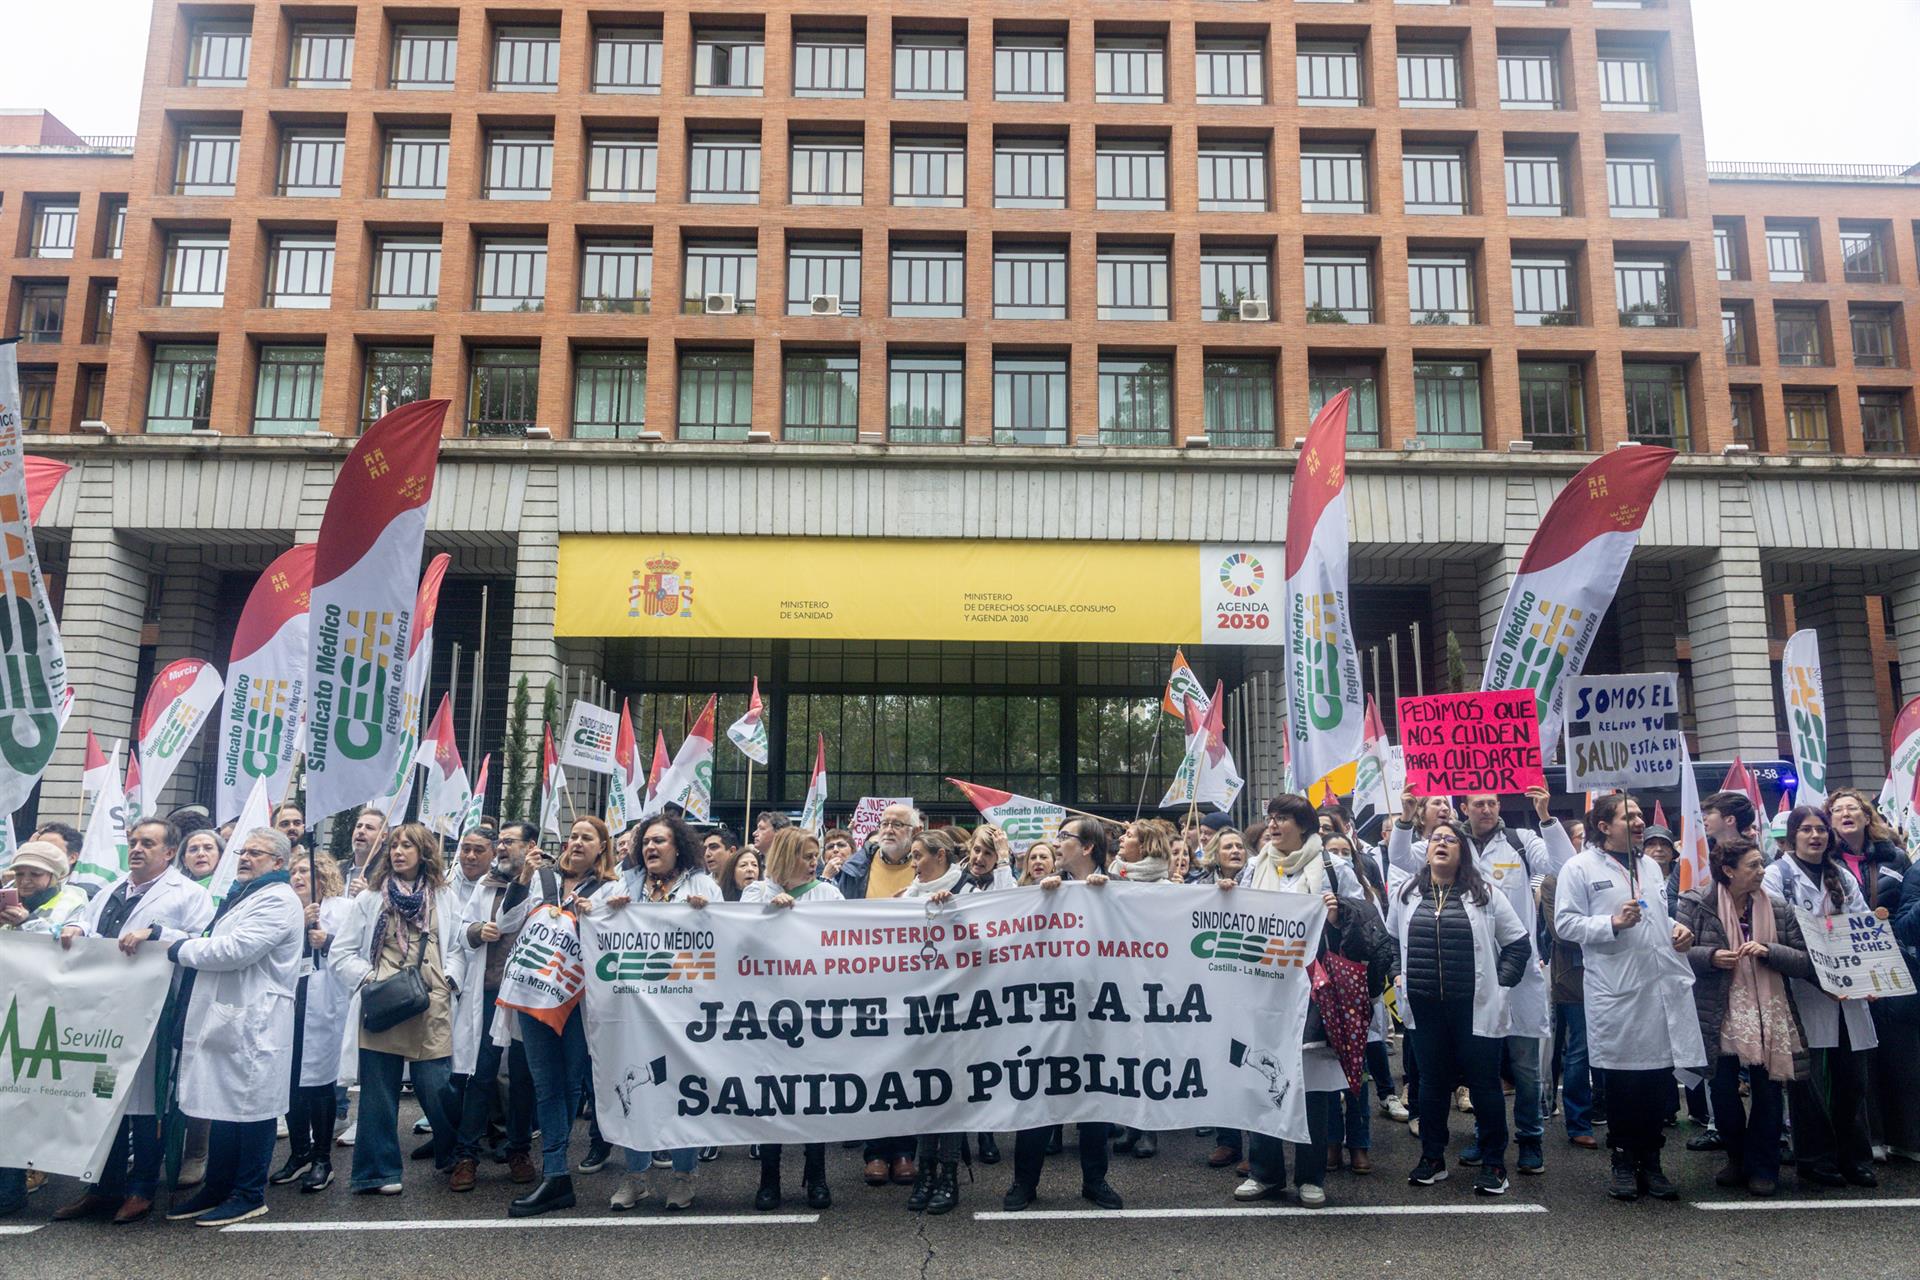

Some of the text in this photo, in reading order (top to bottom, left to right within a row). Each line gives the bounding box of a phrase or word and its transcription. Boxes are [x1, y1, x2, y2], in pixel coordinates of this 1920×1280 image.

[780, 600, 830, 609] MINISTERIO
[964, 593, 1013, 601] MINISTERIO
[964, 603, 976, 611] DE
[978, 603, 1025, 612] DERECHOS
[1070, 605, 1116, 613] CONSUMO
[1216, 602, 1269, 612] AGENDA
[780, 611, 833, 620] DE SANIDAD
[964, 614, 1029, 623] Y AGENDA 2030
[1217, 614, 1270, 630] 2030
[1502, 590, 1536, 651] Médico
[1575, 612, 1598, 656] Murcia
[1342, 639, 1355, 656] de
[169, 665, 198, 681] Murcia
[1293, 592, 1308, 743] Sindicato Médico
[1305, 592, 1343, 731] CESM
[1570, 656, 1581, 673] de
[334, 610, 395, 760] CESM
[385, 611, 409, 736] Región de Murcia
[1342, 657, 1359, 705] Región
[308, 604, 341, 772] Sindicato Médico
[1494, 700, 1535, 719] QUE
[1576, 685, 1673, 720] SOMOS EL
[224, 674, 250, 786] Sindicato Médico
[242, 678, 288, 778] CESM
[281, 680, 303, 762] Región de Murcia
[1642, 717, 1663, 731] TU
[1408, 725, 1445, 745] NOS
[1406, 753, 1438, 769] PARA
[1576, 736, 1677, 777] SALUD ESTÁ EN
[1635, 759, 1673, 773] JUEGO
[1427, 768, 1520, 792] MEJOR
[993, 805, 1063, 816] Sindicato Médico
[821, 912, 1084, 947] MINISTERIO DE SANIDAD:
[1192, 911, 1306, 939] SINDICATO MÉDICO
[1848, 915, 1875, 930] NO
[597, 928, 714, 951] SINDICATO MÉDICO
[1190, 930, 1307, 968] CESM
[1852, 941, 1892, 953] ECHES
[595, 952, 716, 982] CESM
[738, 940, 1169, 976] ÚLTIMA PROPUESTA DE ESTATUTO MARCO
[1208, 963, 1237, 972] Castilla
[1243, 966, 1253, 976] La
[1255, 968, 1285, 980] Mancha
[528, 976, 565, 1003] Mancha
[612, 985, 640, 994] Castilla
[648, 986, 658, 994] La
[660, 985, 693, 994] Mancha
[685, 981, 1212, 1049] JAQUE MATE A LA
[61, 1027, 124, 1049] Sevilla
[40, 1086, 86, 1098] Federación
[678, 1045, 1208, 1117] SANIDAD PÚBLICA
